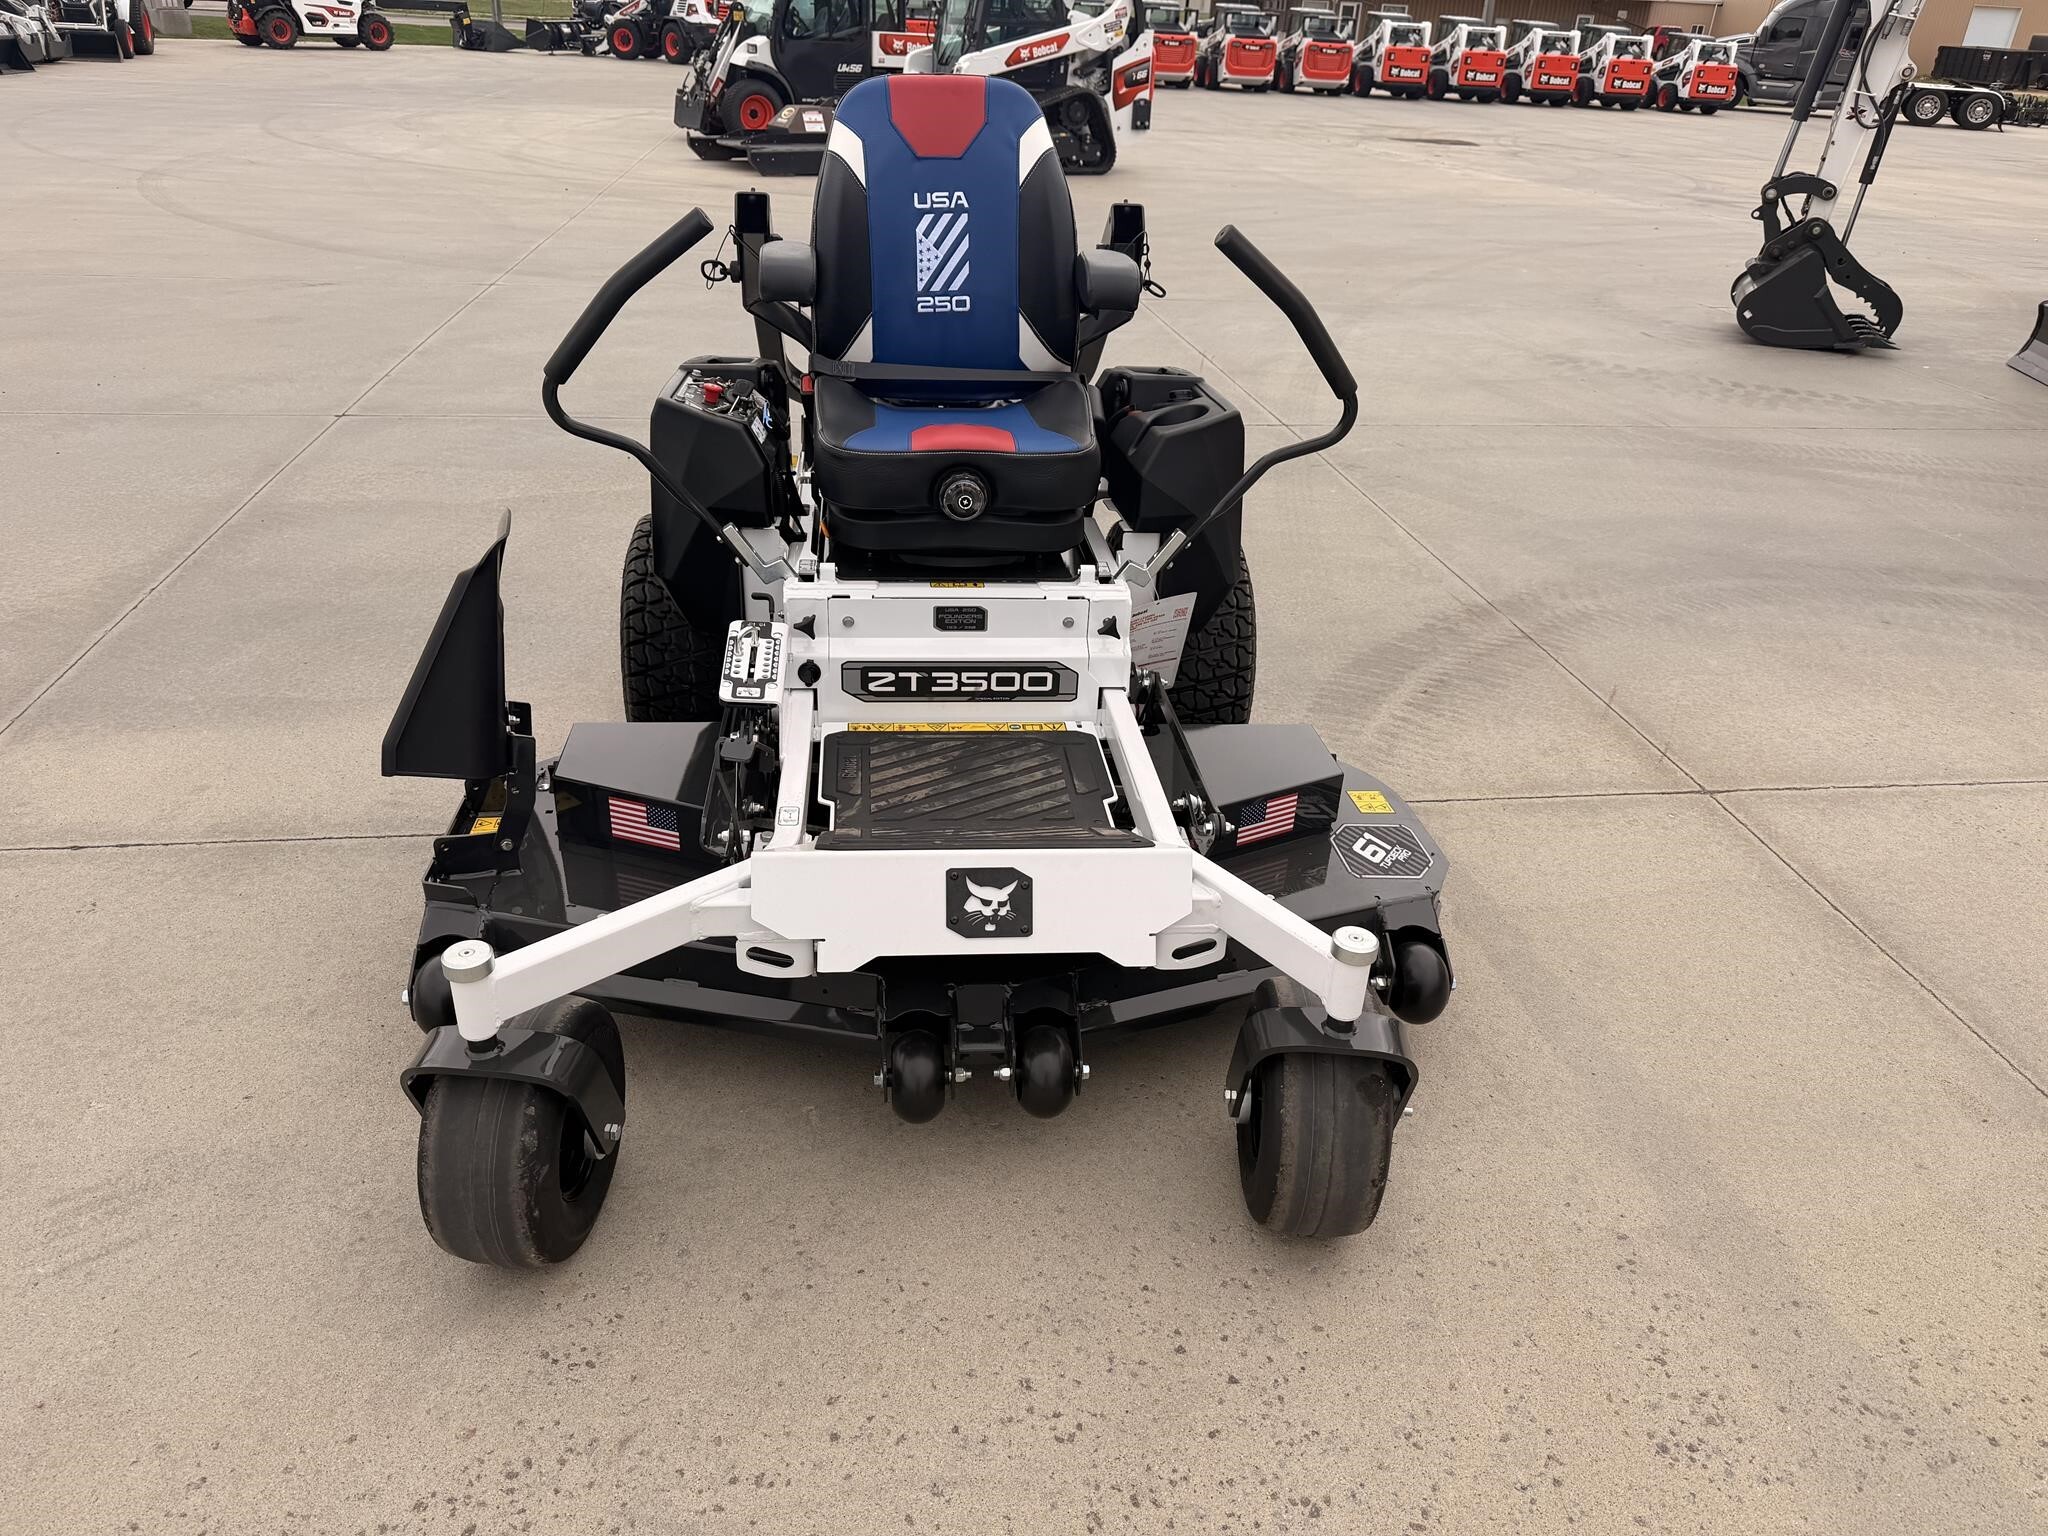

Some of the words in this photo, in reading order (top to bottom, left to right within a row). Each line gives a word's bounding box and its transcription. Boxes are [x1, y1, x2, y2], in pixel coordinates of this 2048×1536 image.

[1032, 42, 1058, 58] Bobcat
[1400, 68, 1420, 78] Bobcat
[1475, 72, 1496, 82] Bobcat
[1549, 76, 1570, 85] Bobcat
[1621, 80, 1642, 89] Bobcat
[1706, 85, 1727, 94] Bobcat
[913, 191, 969, 209] USA
[916, 295, 971, 313] 250
[867, 671, 1053, 692] ZT3500
[1352, 831, 1393, 864] 61
[1379, 844, 1404, 869] TUFDECK
[1397, 848, 1412, 863] PRO
